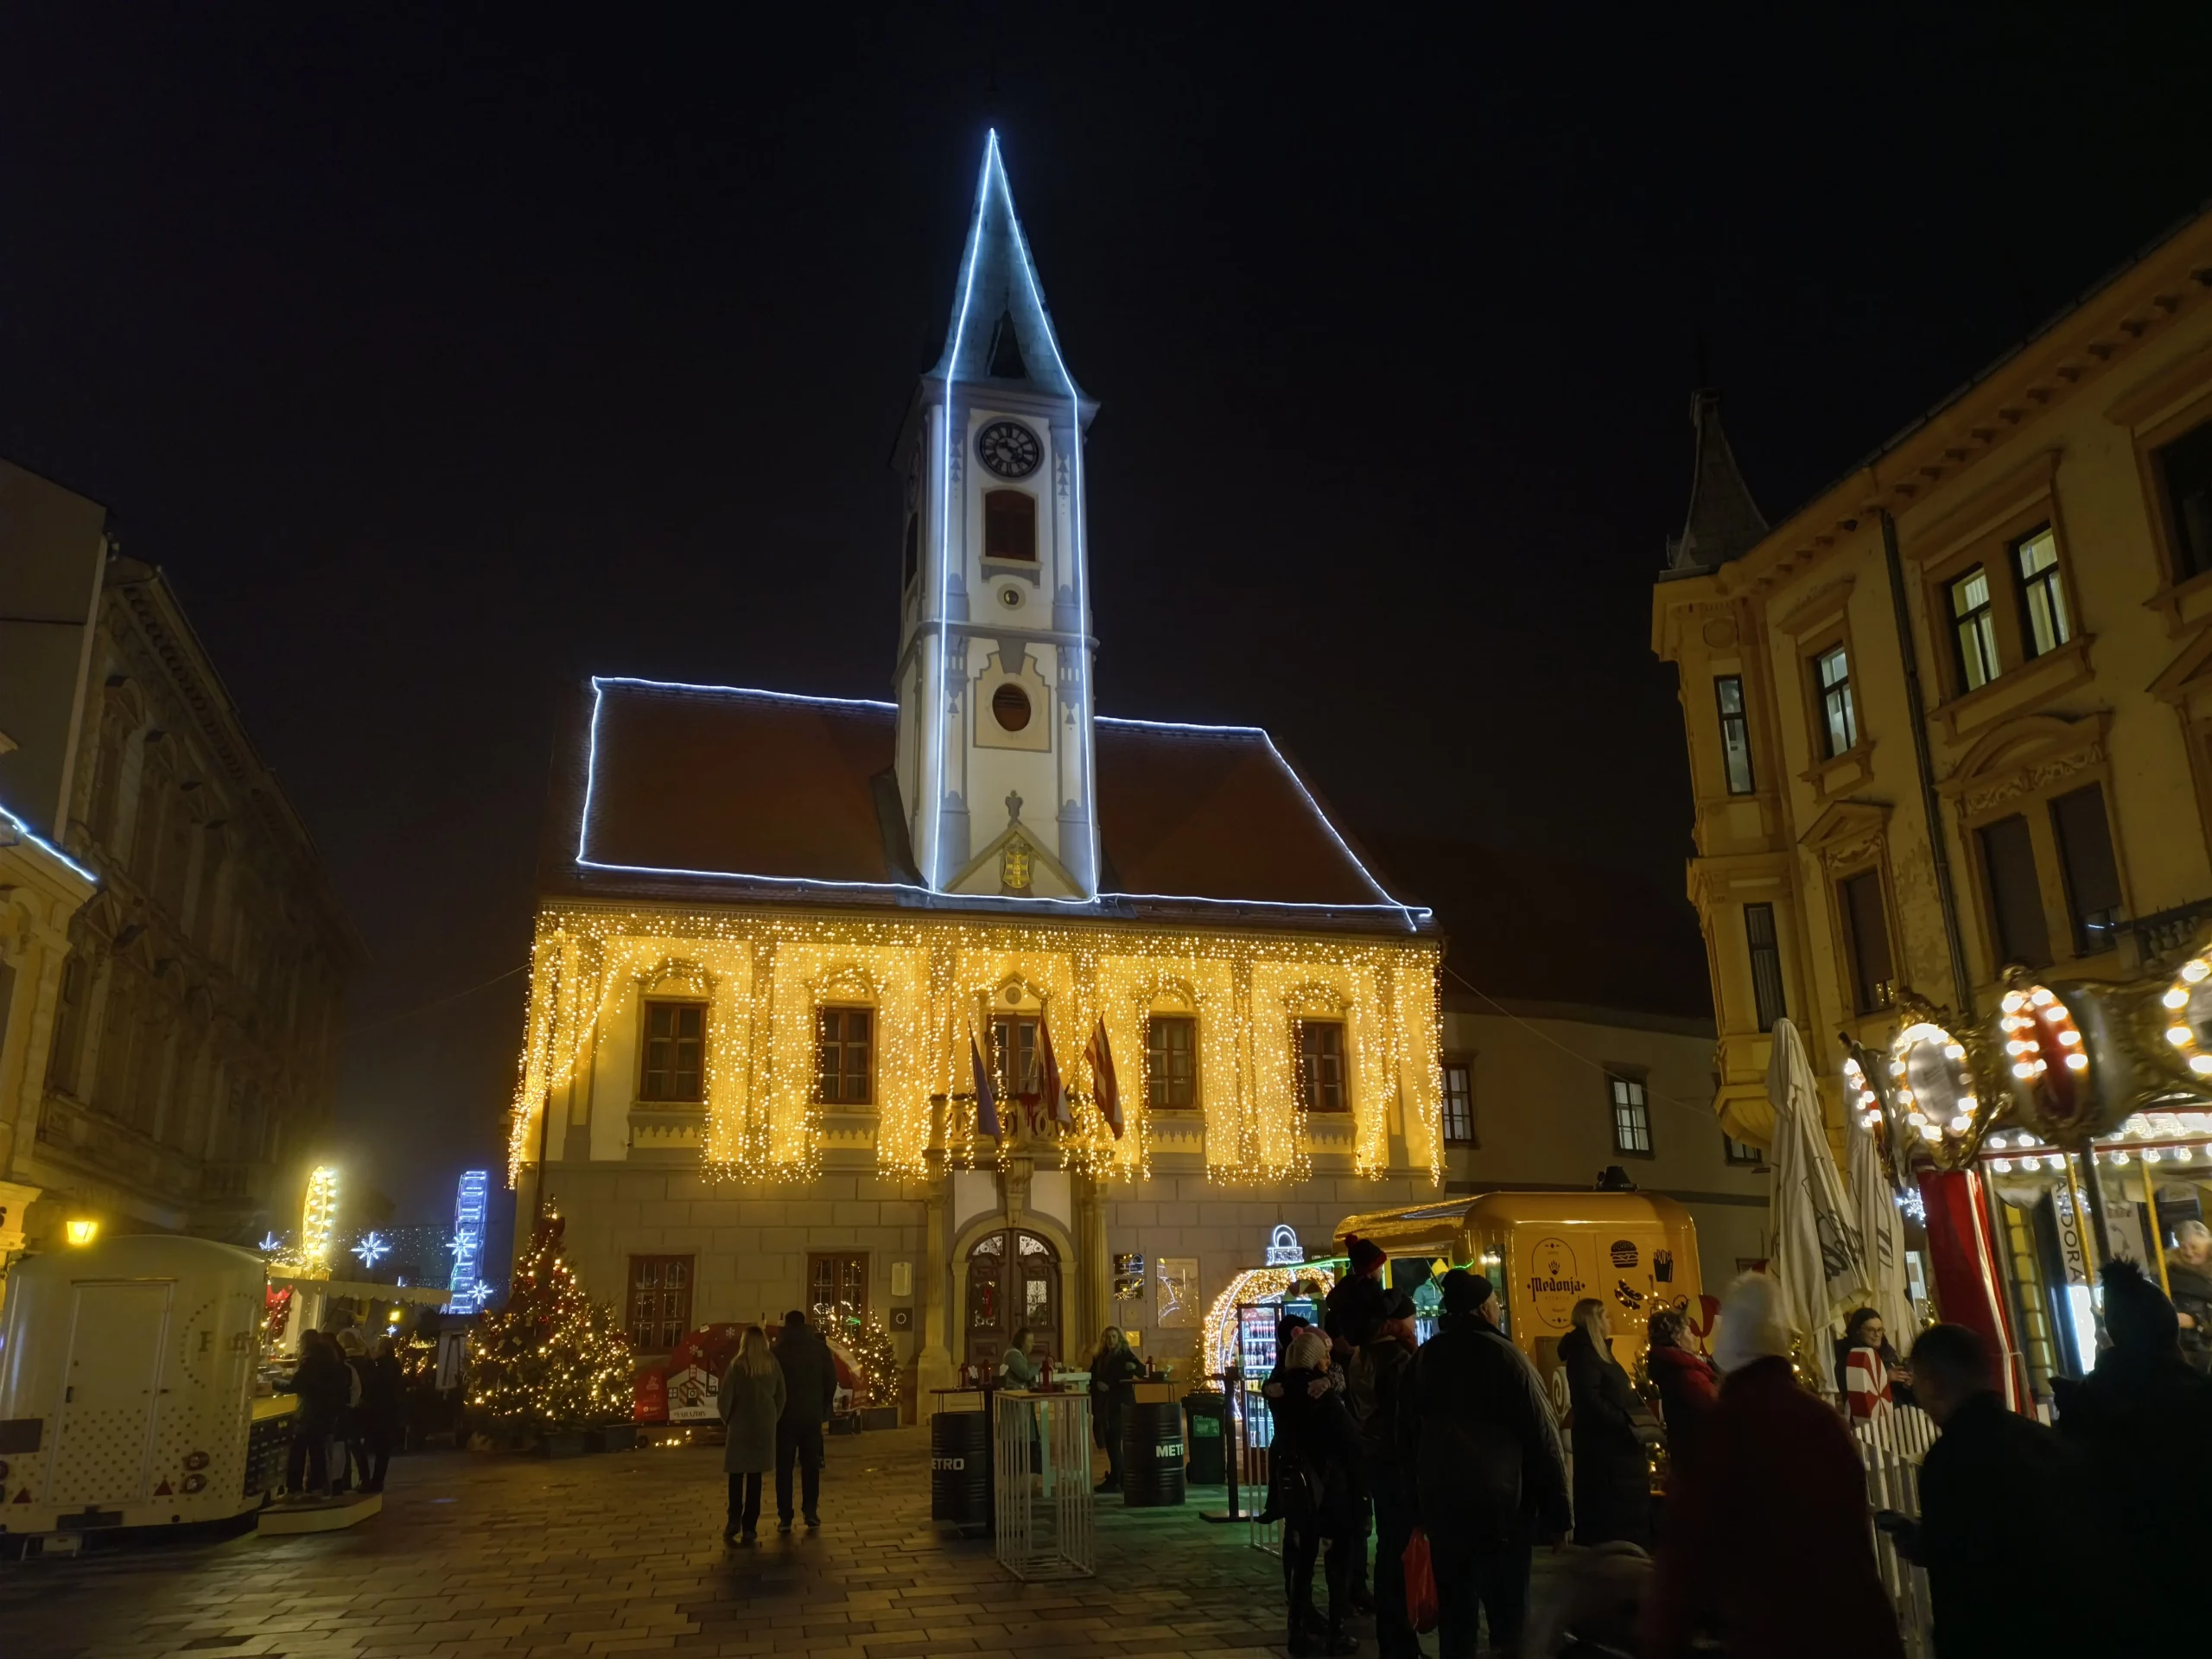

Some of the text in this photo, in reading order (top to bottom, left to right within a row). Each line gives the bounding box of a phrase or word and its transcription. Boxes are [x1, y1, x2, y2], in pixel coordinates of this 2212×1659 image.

[2056, 1181, 2085, 1283] ANDORA
[1531, 1276, 1581, 1302] Medonja
[1156, 1444, 1184, 1458] MET
[932, 1458, 964, 1471] ETRO
